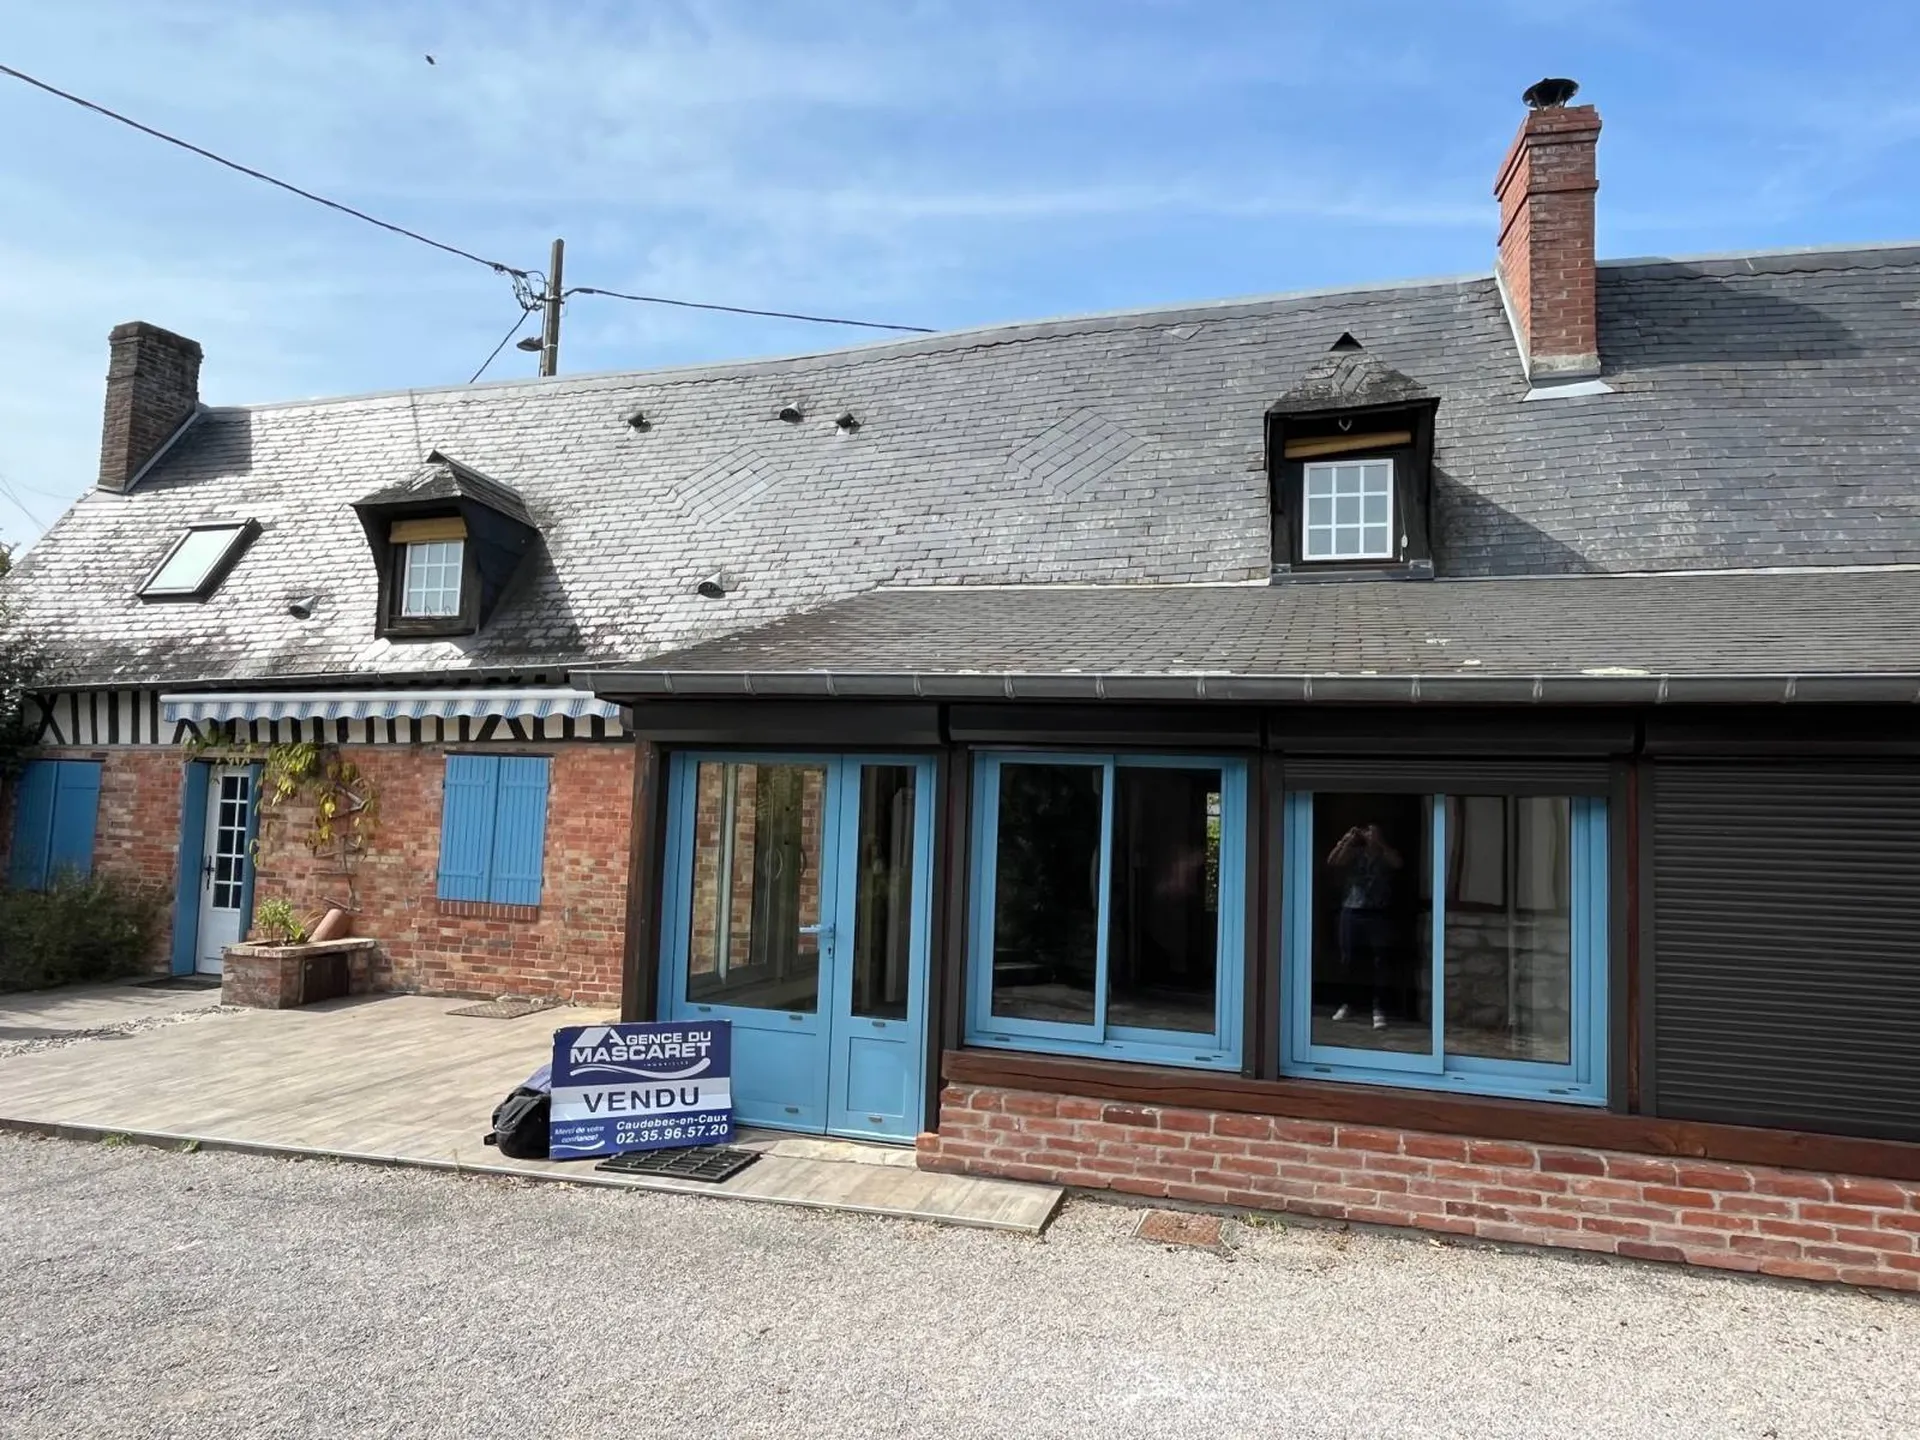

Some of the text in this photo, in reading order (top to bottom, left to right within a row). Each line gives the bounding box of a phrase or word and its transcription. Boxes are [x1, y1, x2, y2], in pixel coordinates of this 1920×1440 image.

[608, 1029, 711, 1045] AGENCE DU
[570, 1043, 711, 1064] MASCARET
[583, 1087, 700, 1113] VENDU
[616, 1114, 728, 1131] Caudebec-en-Caux
[616, 1124, 729, 1145] 02.35.96.57.20
